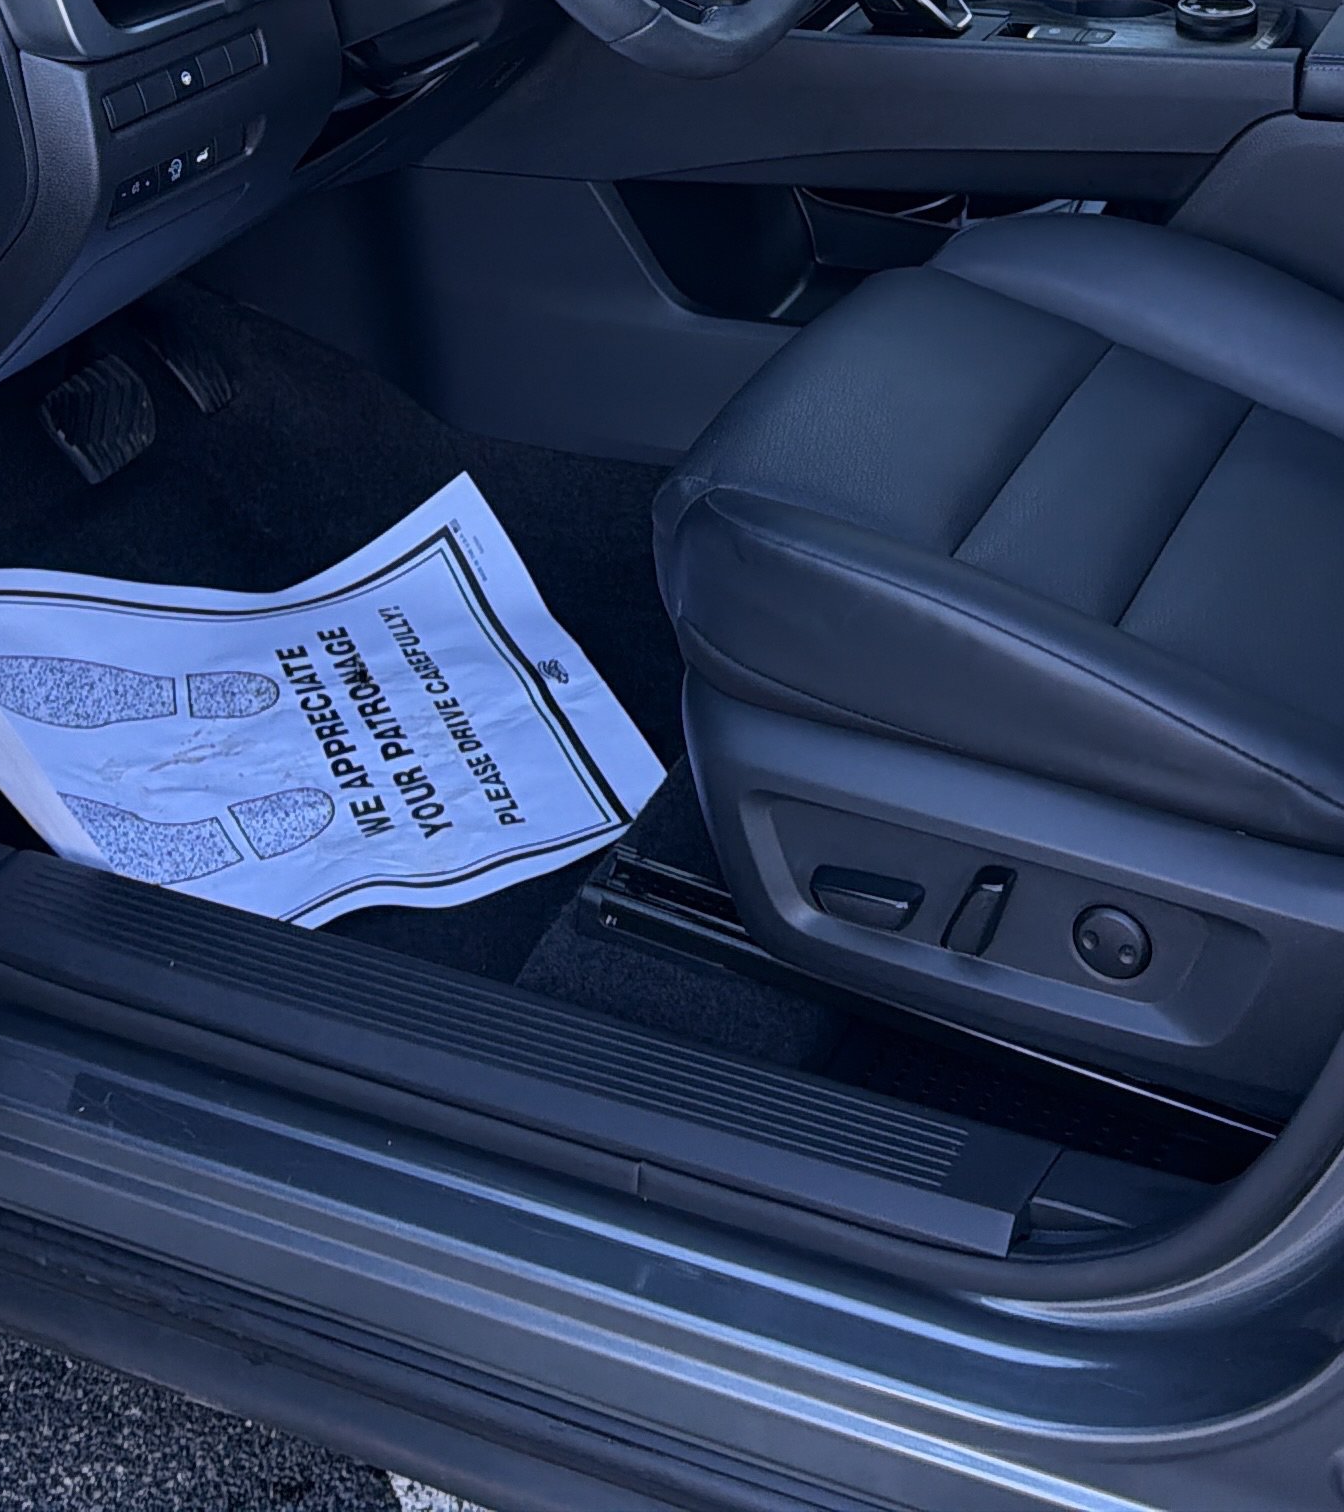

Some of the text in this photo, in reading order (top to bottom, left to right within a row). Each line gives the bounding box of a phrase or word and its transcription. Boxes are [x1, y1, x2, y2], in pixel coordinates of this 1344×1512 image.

[274, 644, 396, 838] WE APPRECIATE
[317, 626, 454, 839] YOUR PATRONAGE
[377, 604, 526, 826] PLEASE DRIVE CAREFULLY!
